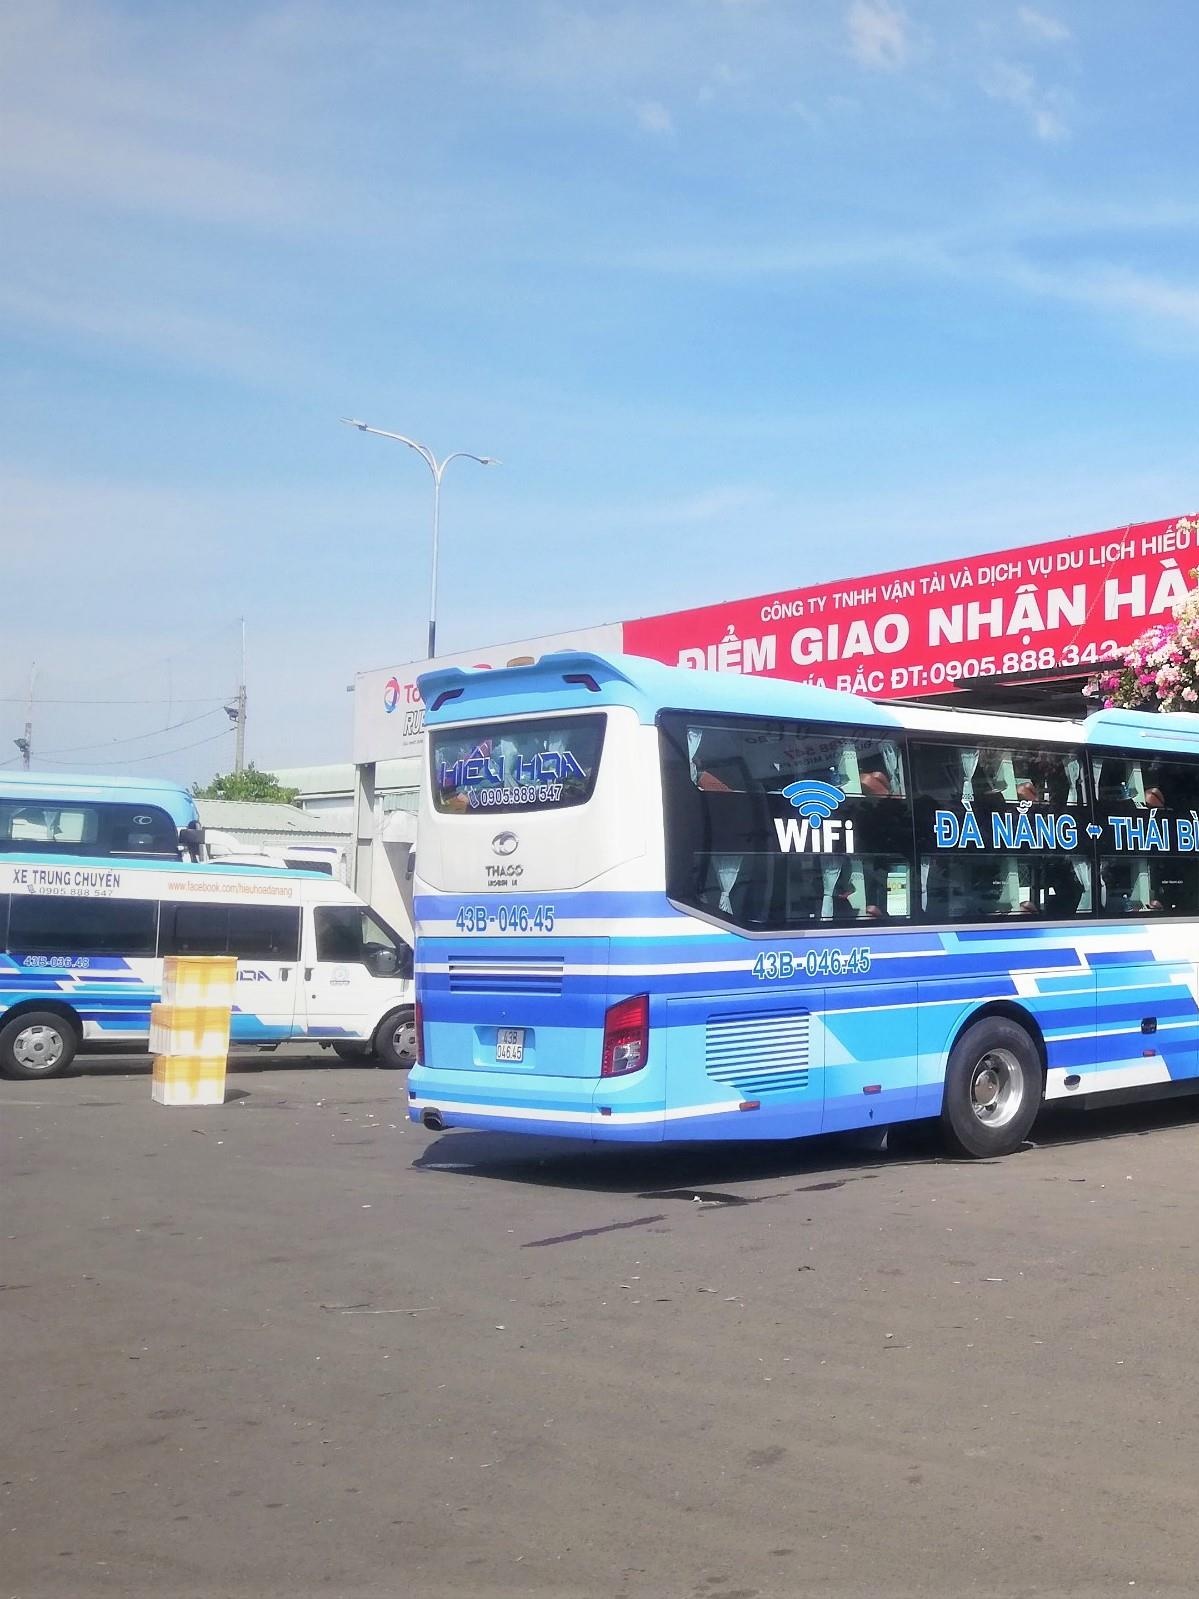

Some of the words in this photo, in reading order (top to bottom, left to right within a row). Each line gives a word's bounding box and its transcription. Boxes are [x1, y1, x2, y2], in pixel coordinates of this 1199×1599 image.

[760, 600, 804, 622] CÔNG
[808, 596, 827, 614] TY
[832, 587, 877, 609] TNHH
[880, 579, 915, 603] VẬN
[919, 571, 946, 595] TẢI
[949, 566, 974, 589] VÀ
[977, 561, 1022, 587] DỊCH
[1027, 553, 1053, 579] VỤ
[1056, 550, 1084, 572] DU
[1088, 540, 1135, 567] LỊCH
[1141, 525, 1190, 556] HIẾU
[790, 613, 910, 667] GIAO
[928, 583, 1087, 647] NHẬN
[836, 666, 884, 694] BẮC
[538, 784, 564, 803] 547
[773, 814, 854, 853] WiFi
[934, 800, 985, 849] ĐÀ
[991, 800, 1078, 850] NẴNG
[1108, 808, 1171, 851] THÁI
[13, 869, 28, 884] XE
[33, 870, 71, 885] TRUNG
